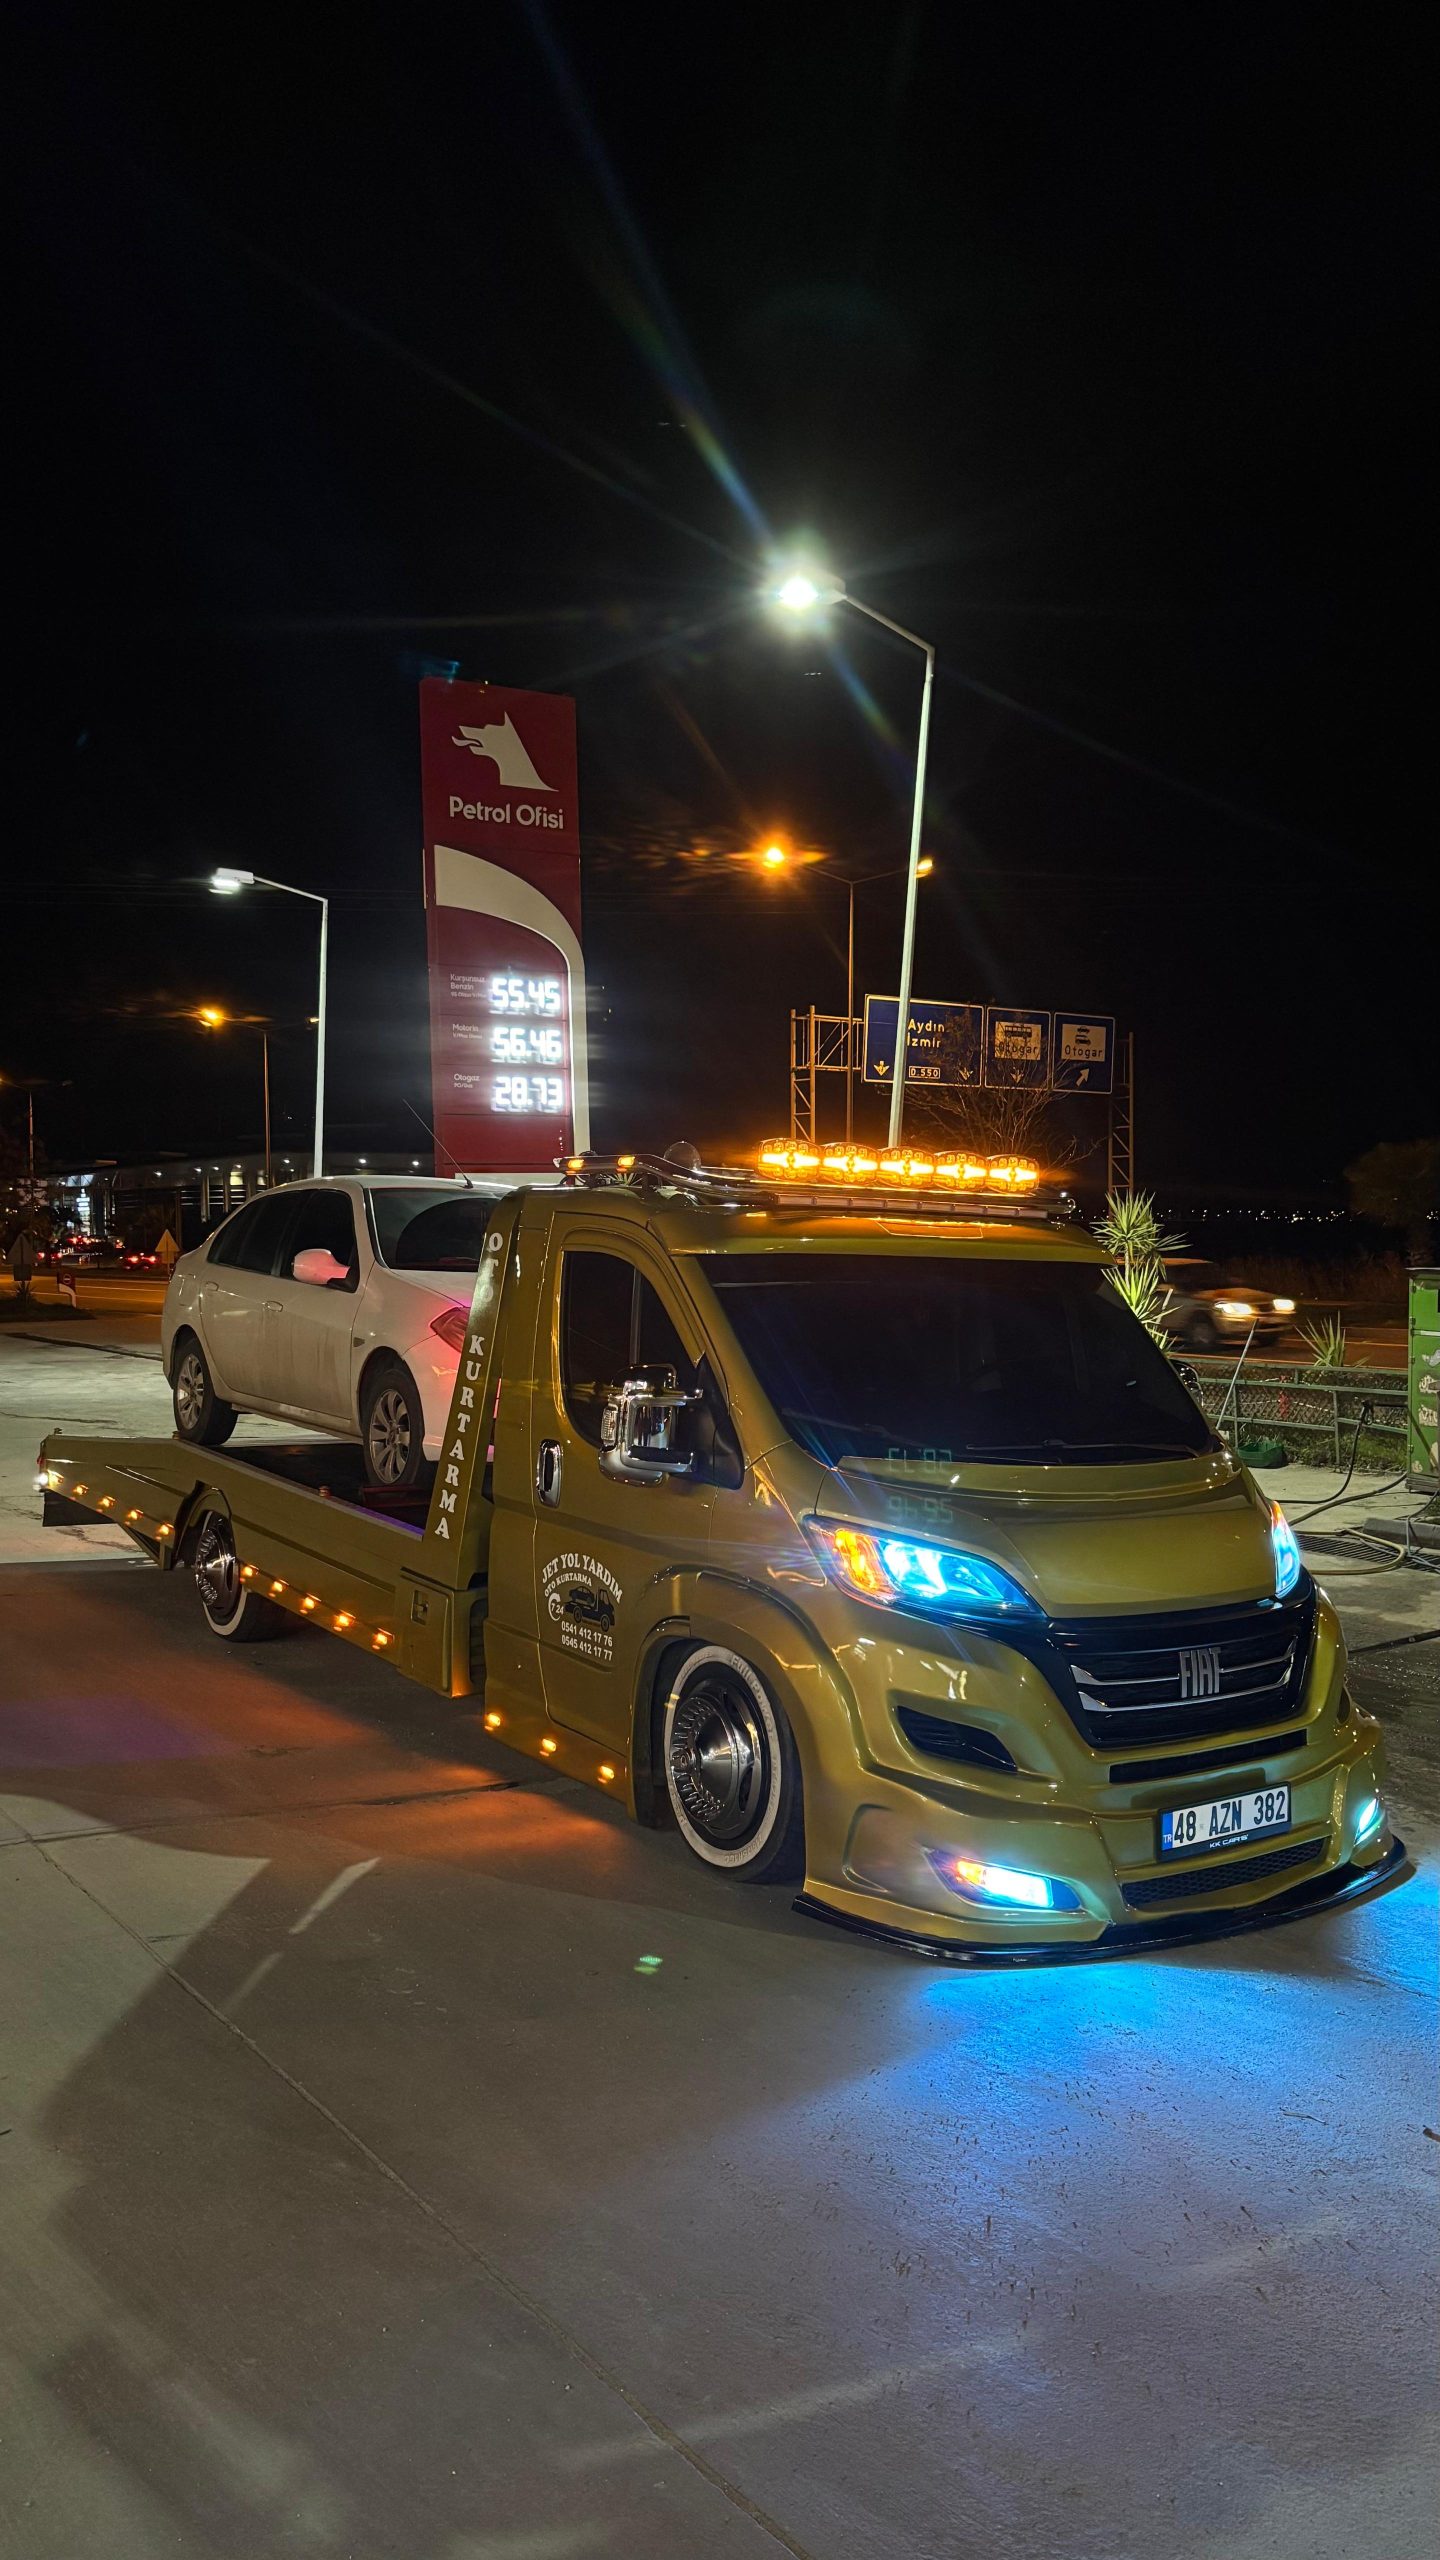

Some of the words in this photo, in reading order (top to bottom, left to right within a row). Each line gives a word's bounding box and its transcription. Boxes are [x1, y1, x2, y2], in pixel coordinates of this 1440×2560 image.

[449, 795, 511, 824] Petrol
[515, 804, 564, 830] Ofisi
[491, 977, 562, 1010] 55.45
[908, 1018, 945, 1034] Aydın
[492, 1026, 563, 1059] 56.46
[1064, 1044, 1103, 1059] Otogar
[454, 1073, 480, 1083] Otogaz
[493, 1076, 563, 1106] 28.73
[434, 1334, 485, 1540] KURTARMA
[542, 1557, 559, 1584] JET
[560, 1553, 581, 1569] YOL
[582, 1554, 623, 1604] YARDIM
[544, 1581, 556, 1598] OTO
[556, 1572, 593, 1587] KURTARMA
[561, 1621, 577, 1635] 0541
[579, 1627, 592, 1640] 412
[593, 1631, 602, 1644] 17
[603, 1635, 613, 1647] 76
[561, 1634, 578, 1649] 0545
[579, 1641, 592, 1654] 412
[593, 1646, 602, 1657] 17
[603, 1649, 613, 1661] 77
[1178, 1647, 1221, 1698] FIAT
[1173, 1810, 1197, 1844] 48
[1208, 1799, 1243, 1837] AZN
[1253, 1790, 1286, 1825] 382
[1163, 1834, 1172, 1843] TR
